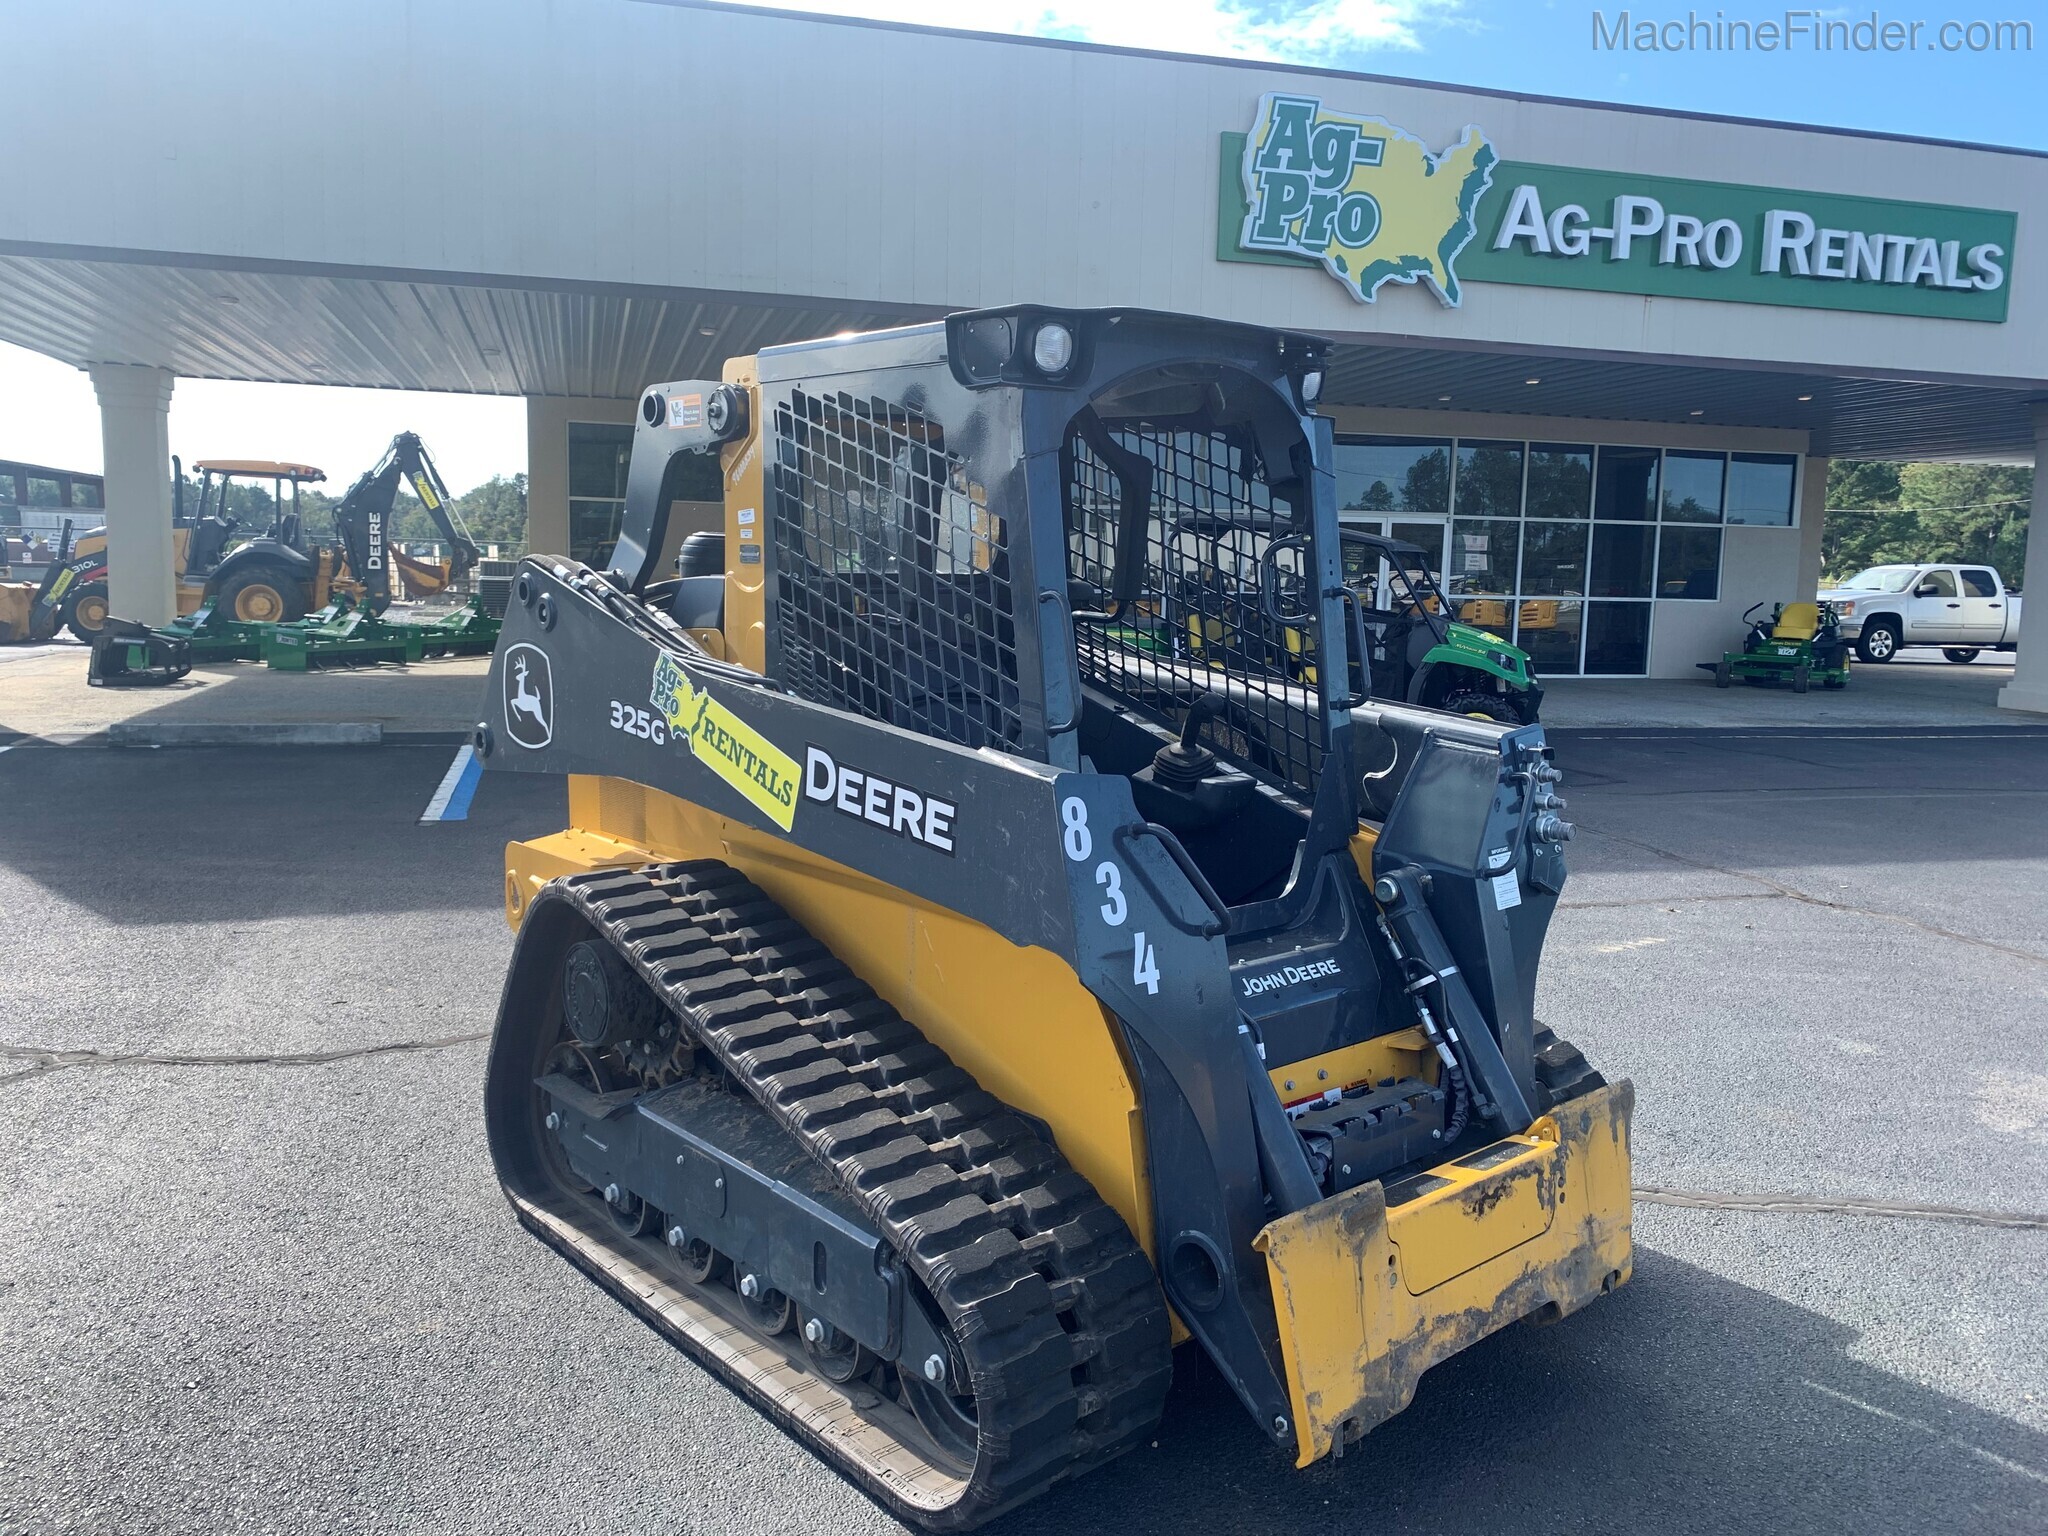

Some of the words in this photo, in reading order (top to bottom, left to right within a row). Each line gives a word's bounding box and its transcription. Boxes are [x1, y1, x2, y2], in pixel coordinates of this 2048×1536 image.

[1253, 97, 1386, 194] Ag-
[1250, 170, 1382, 249] Pro
[1760, 208, 2006, 291] RENTALS
[71, 560, 98, 574] 310L
[368, 512, 382, 570] DEERE
[610, 700, 665, 745] 325G
[652, 681, 681, 718] Pro
[702, 717, 793, 807] RENTALS
[805, 747, 955, 852] DEERE
[1241, 972, 1287, 997] JOHN
[1282, 959, 1341, 985] DEERE
